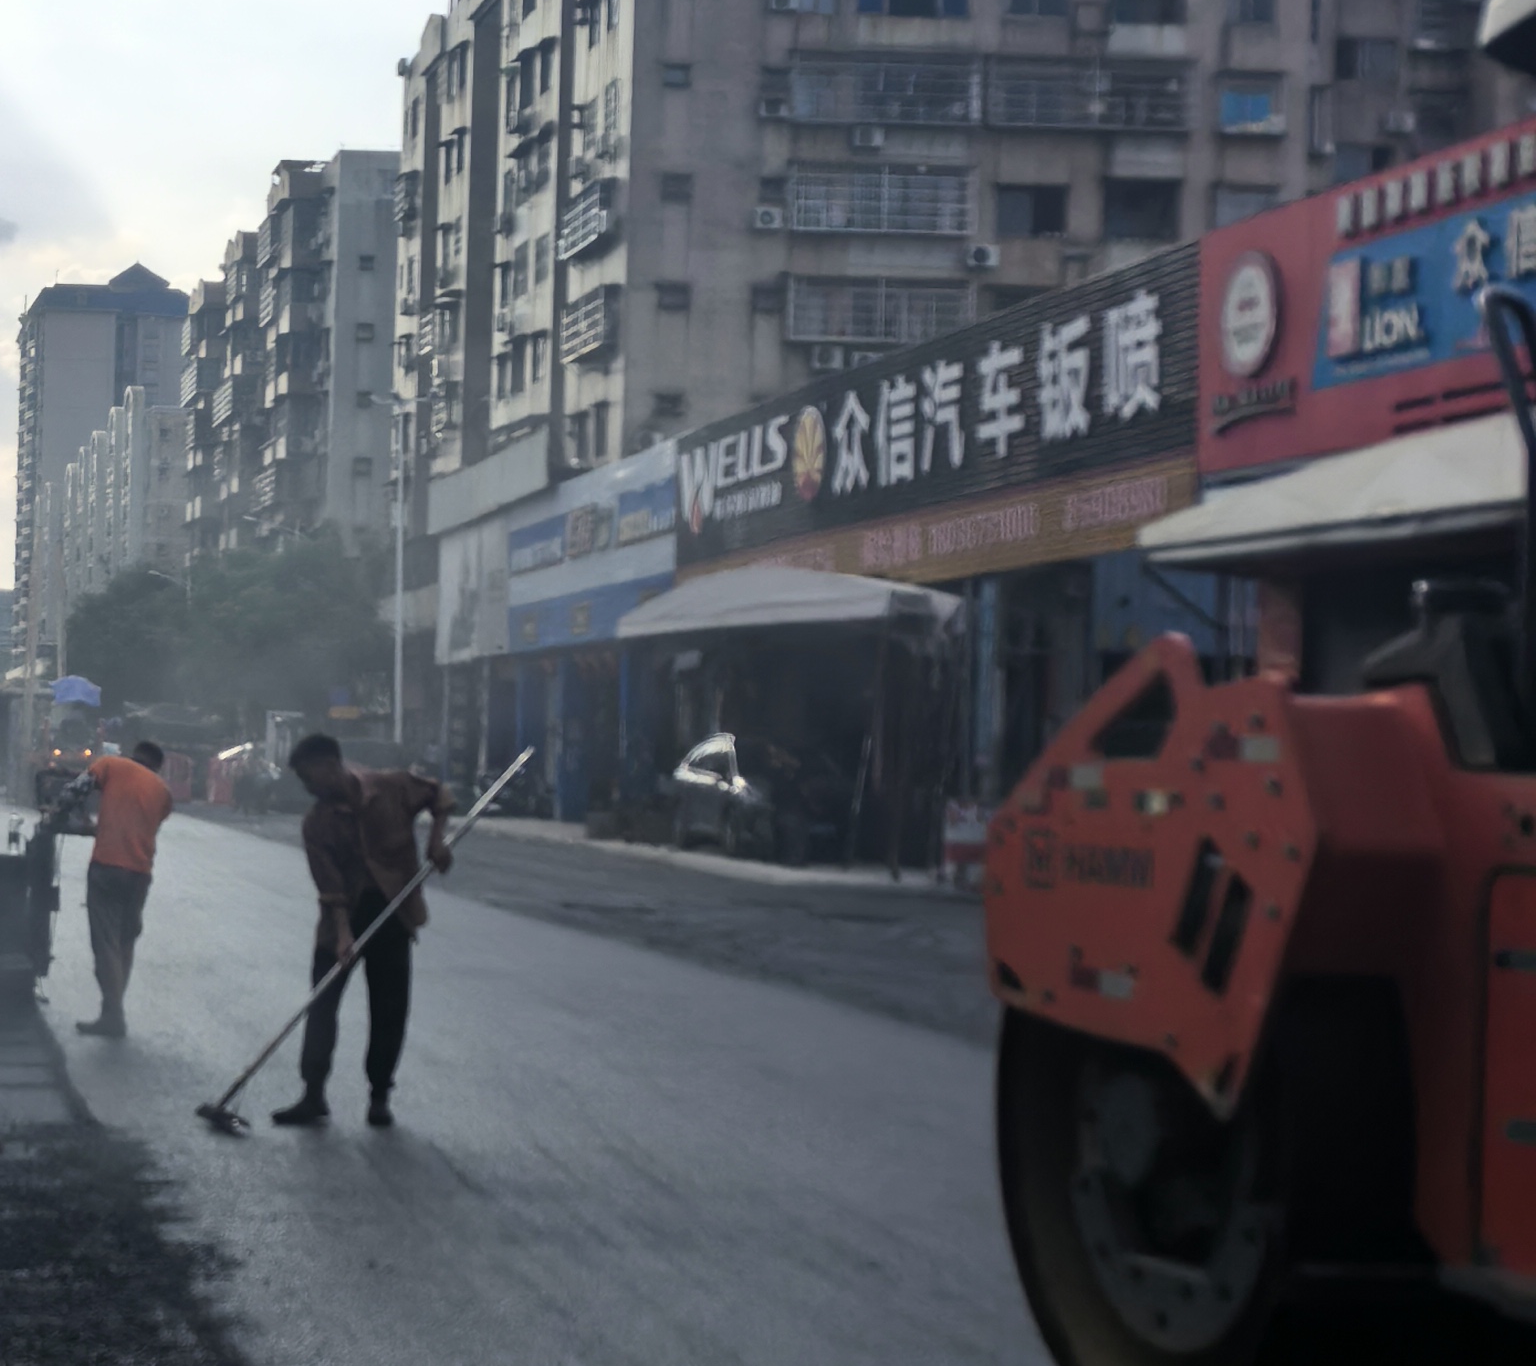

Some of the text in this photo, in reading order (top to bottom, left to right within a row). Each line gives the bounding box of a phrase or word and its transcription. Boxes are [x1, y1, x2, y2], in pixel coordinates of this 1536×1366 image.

[680, 415, 791, 523] WELLS
[831, 289, 1165, 497] 众信汽车钣喷
